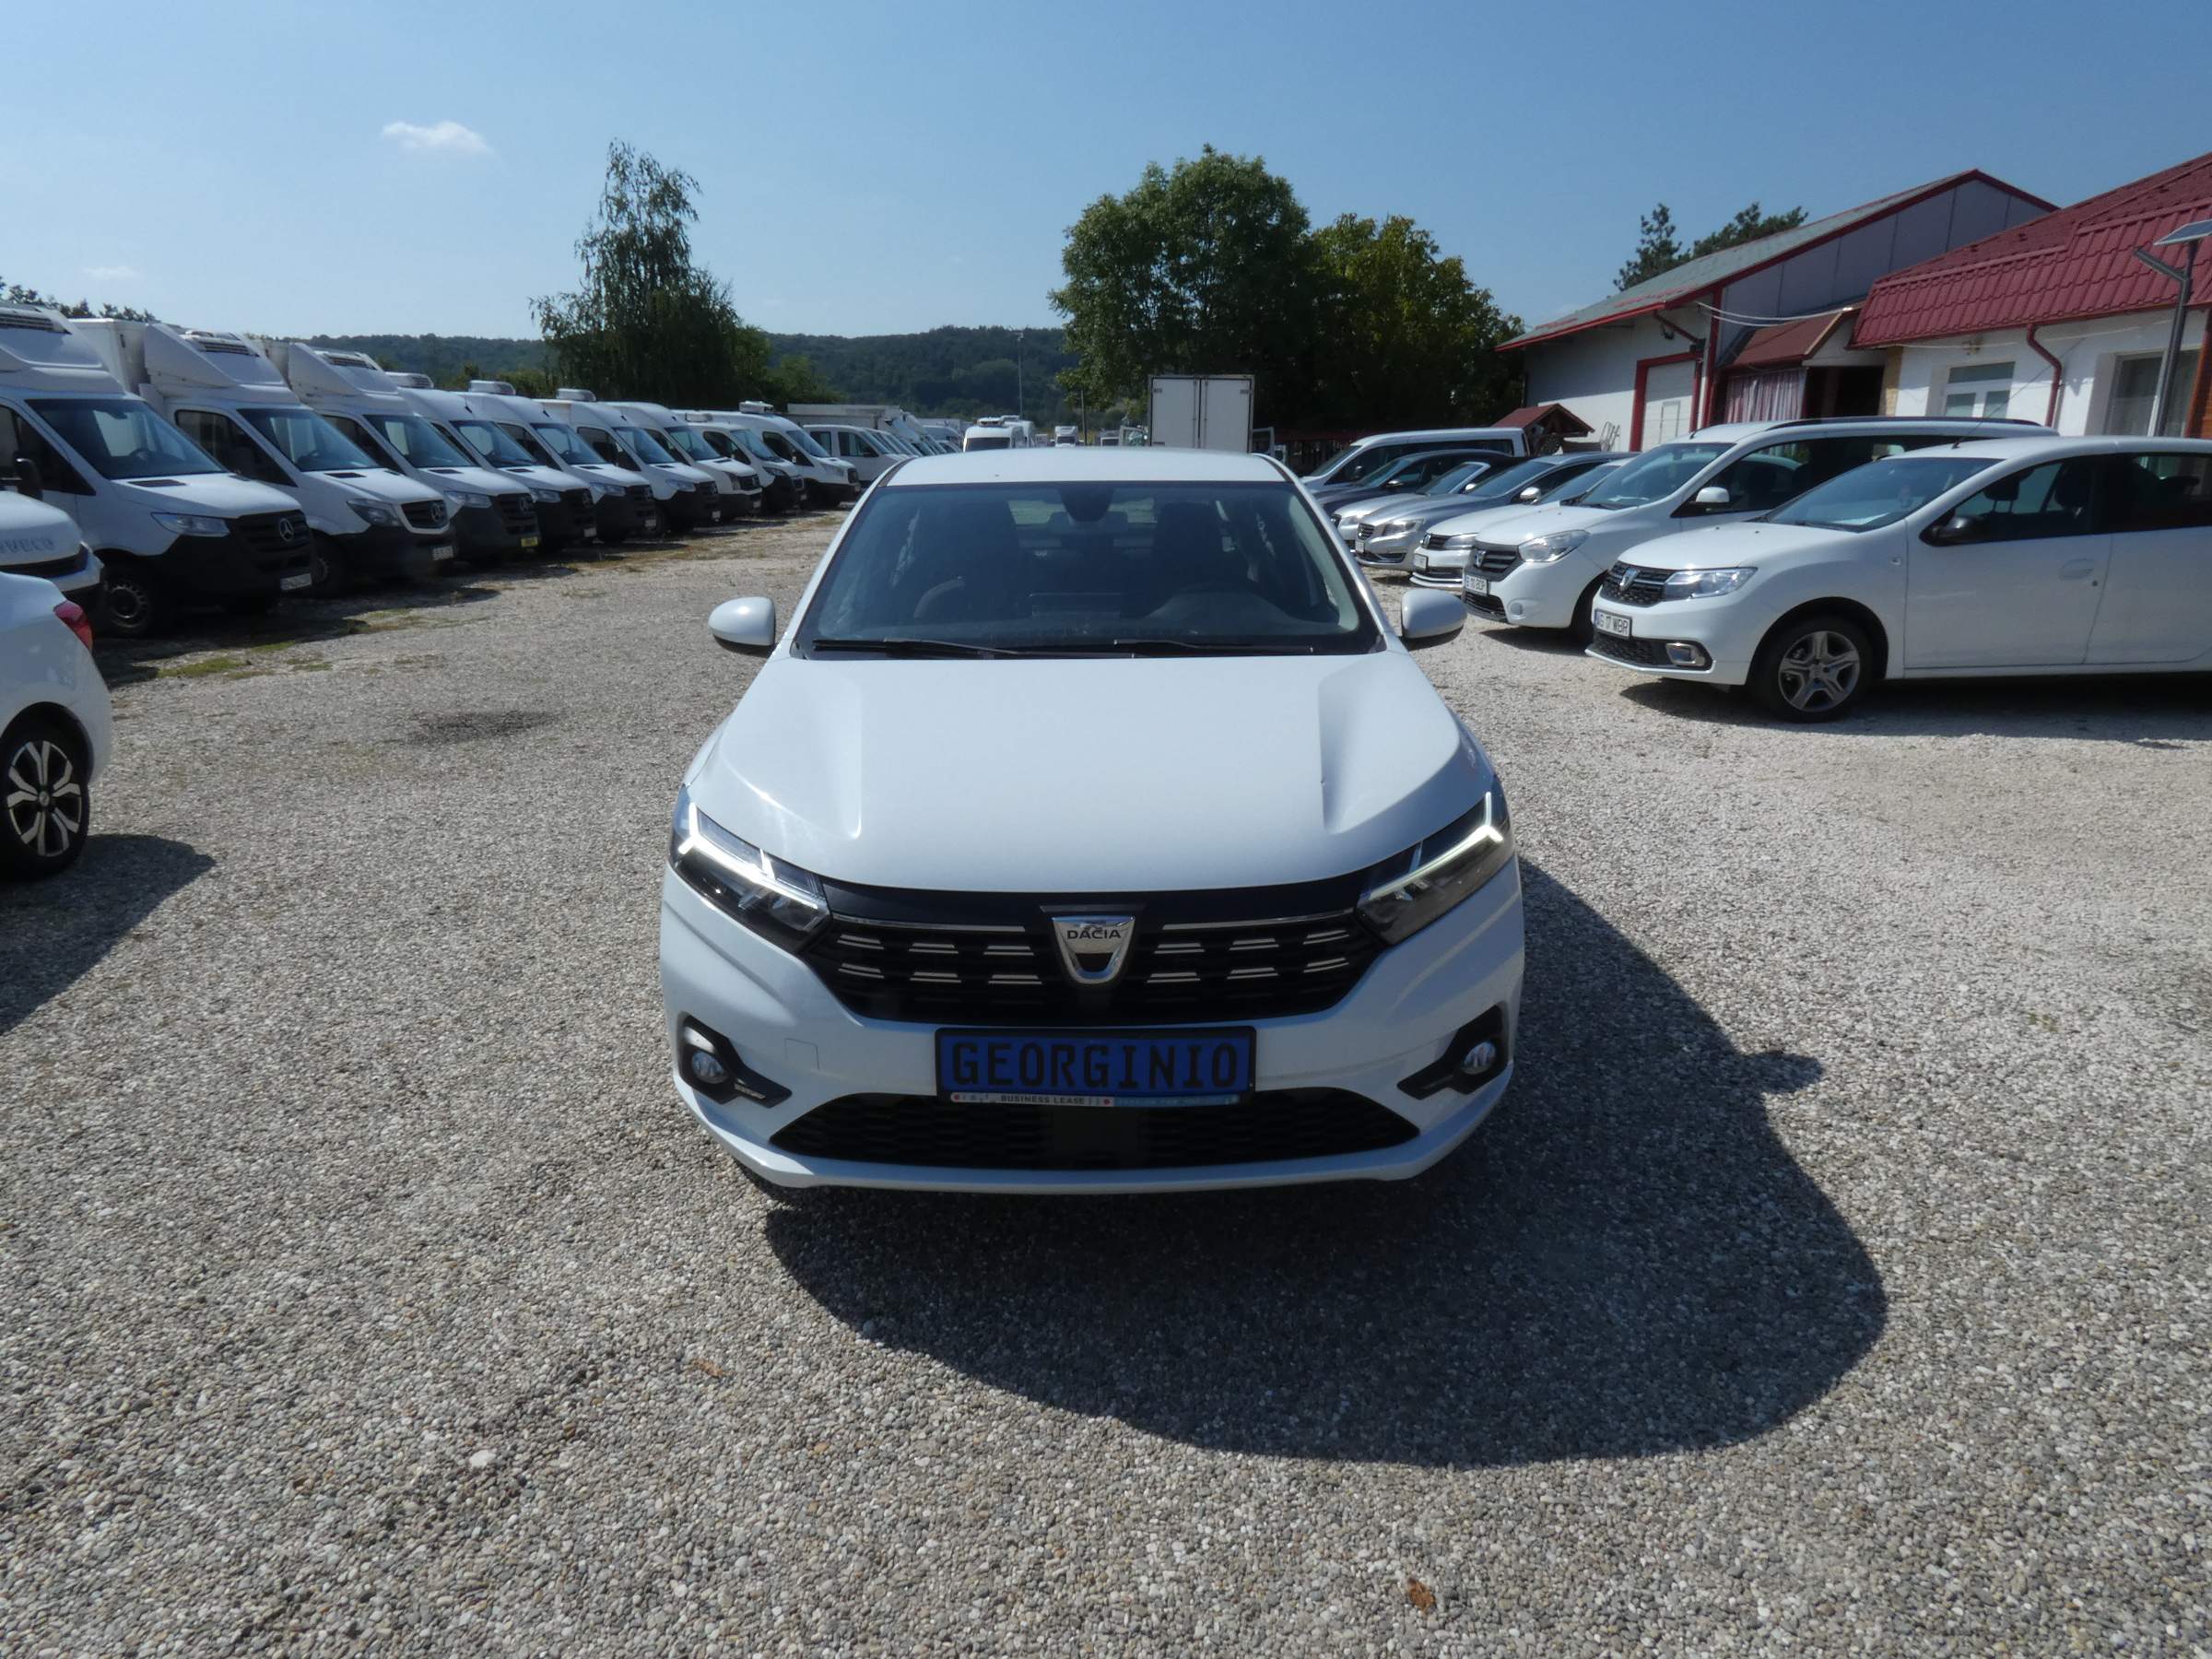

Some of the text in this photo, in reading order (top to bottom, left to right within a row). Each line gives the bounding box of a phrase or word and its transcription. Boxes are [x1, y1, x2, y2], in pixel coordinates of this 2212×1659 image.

[1066, 929, 1122, 940] DACIA
[952, 1041, 1239, 1089] GEORGINIO
[1000, 1095, 1086, 1105] BUSINESS LEASE
